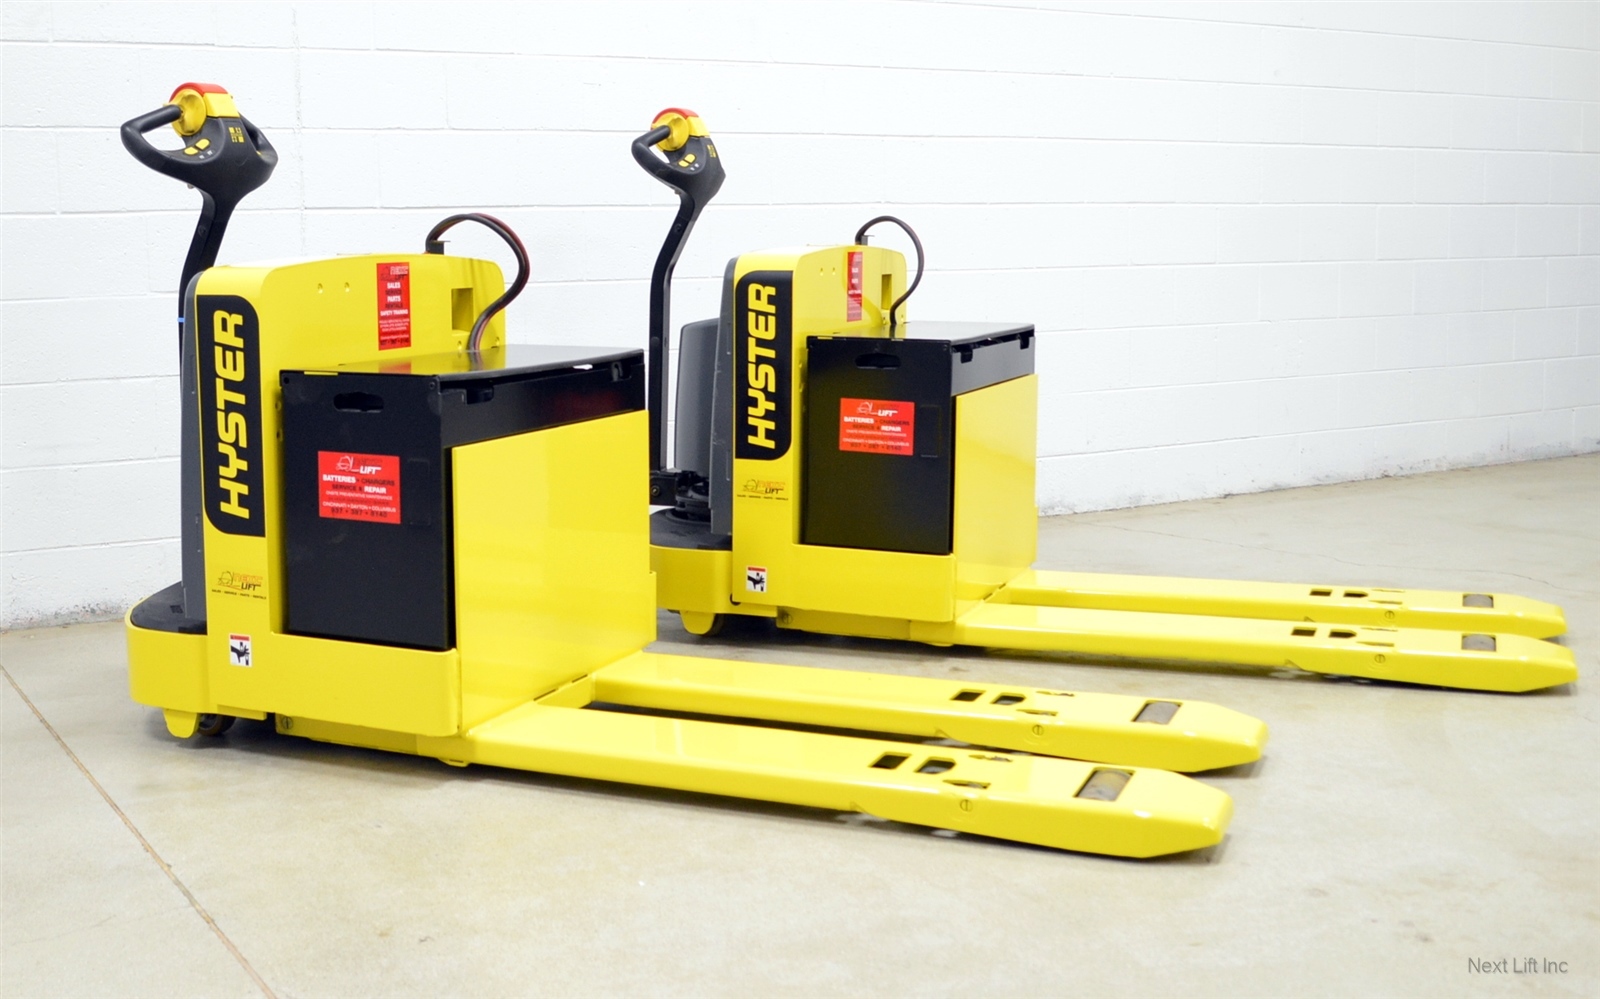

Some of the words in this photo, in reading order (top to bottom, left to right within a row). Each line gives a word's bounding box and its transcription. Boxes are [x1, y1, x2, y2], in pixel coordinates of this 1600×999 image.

[748, 283, 776, 449] HYSTER
[213, 310, 249, 509] HYSTER
[878, 409, 898, 417] LIFT
[843, 416, 875, 424] BATTERIES
[881, 425, 902, 433] REPAIR
[360, 465, 382, 475] LIFT
[322, 474, 356, 484] BATTERIES
[364, 485, 387, 494] REPAIR
[765, 487, 784, 495] LIFT
[241, 582, 262, 591] LIFT
